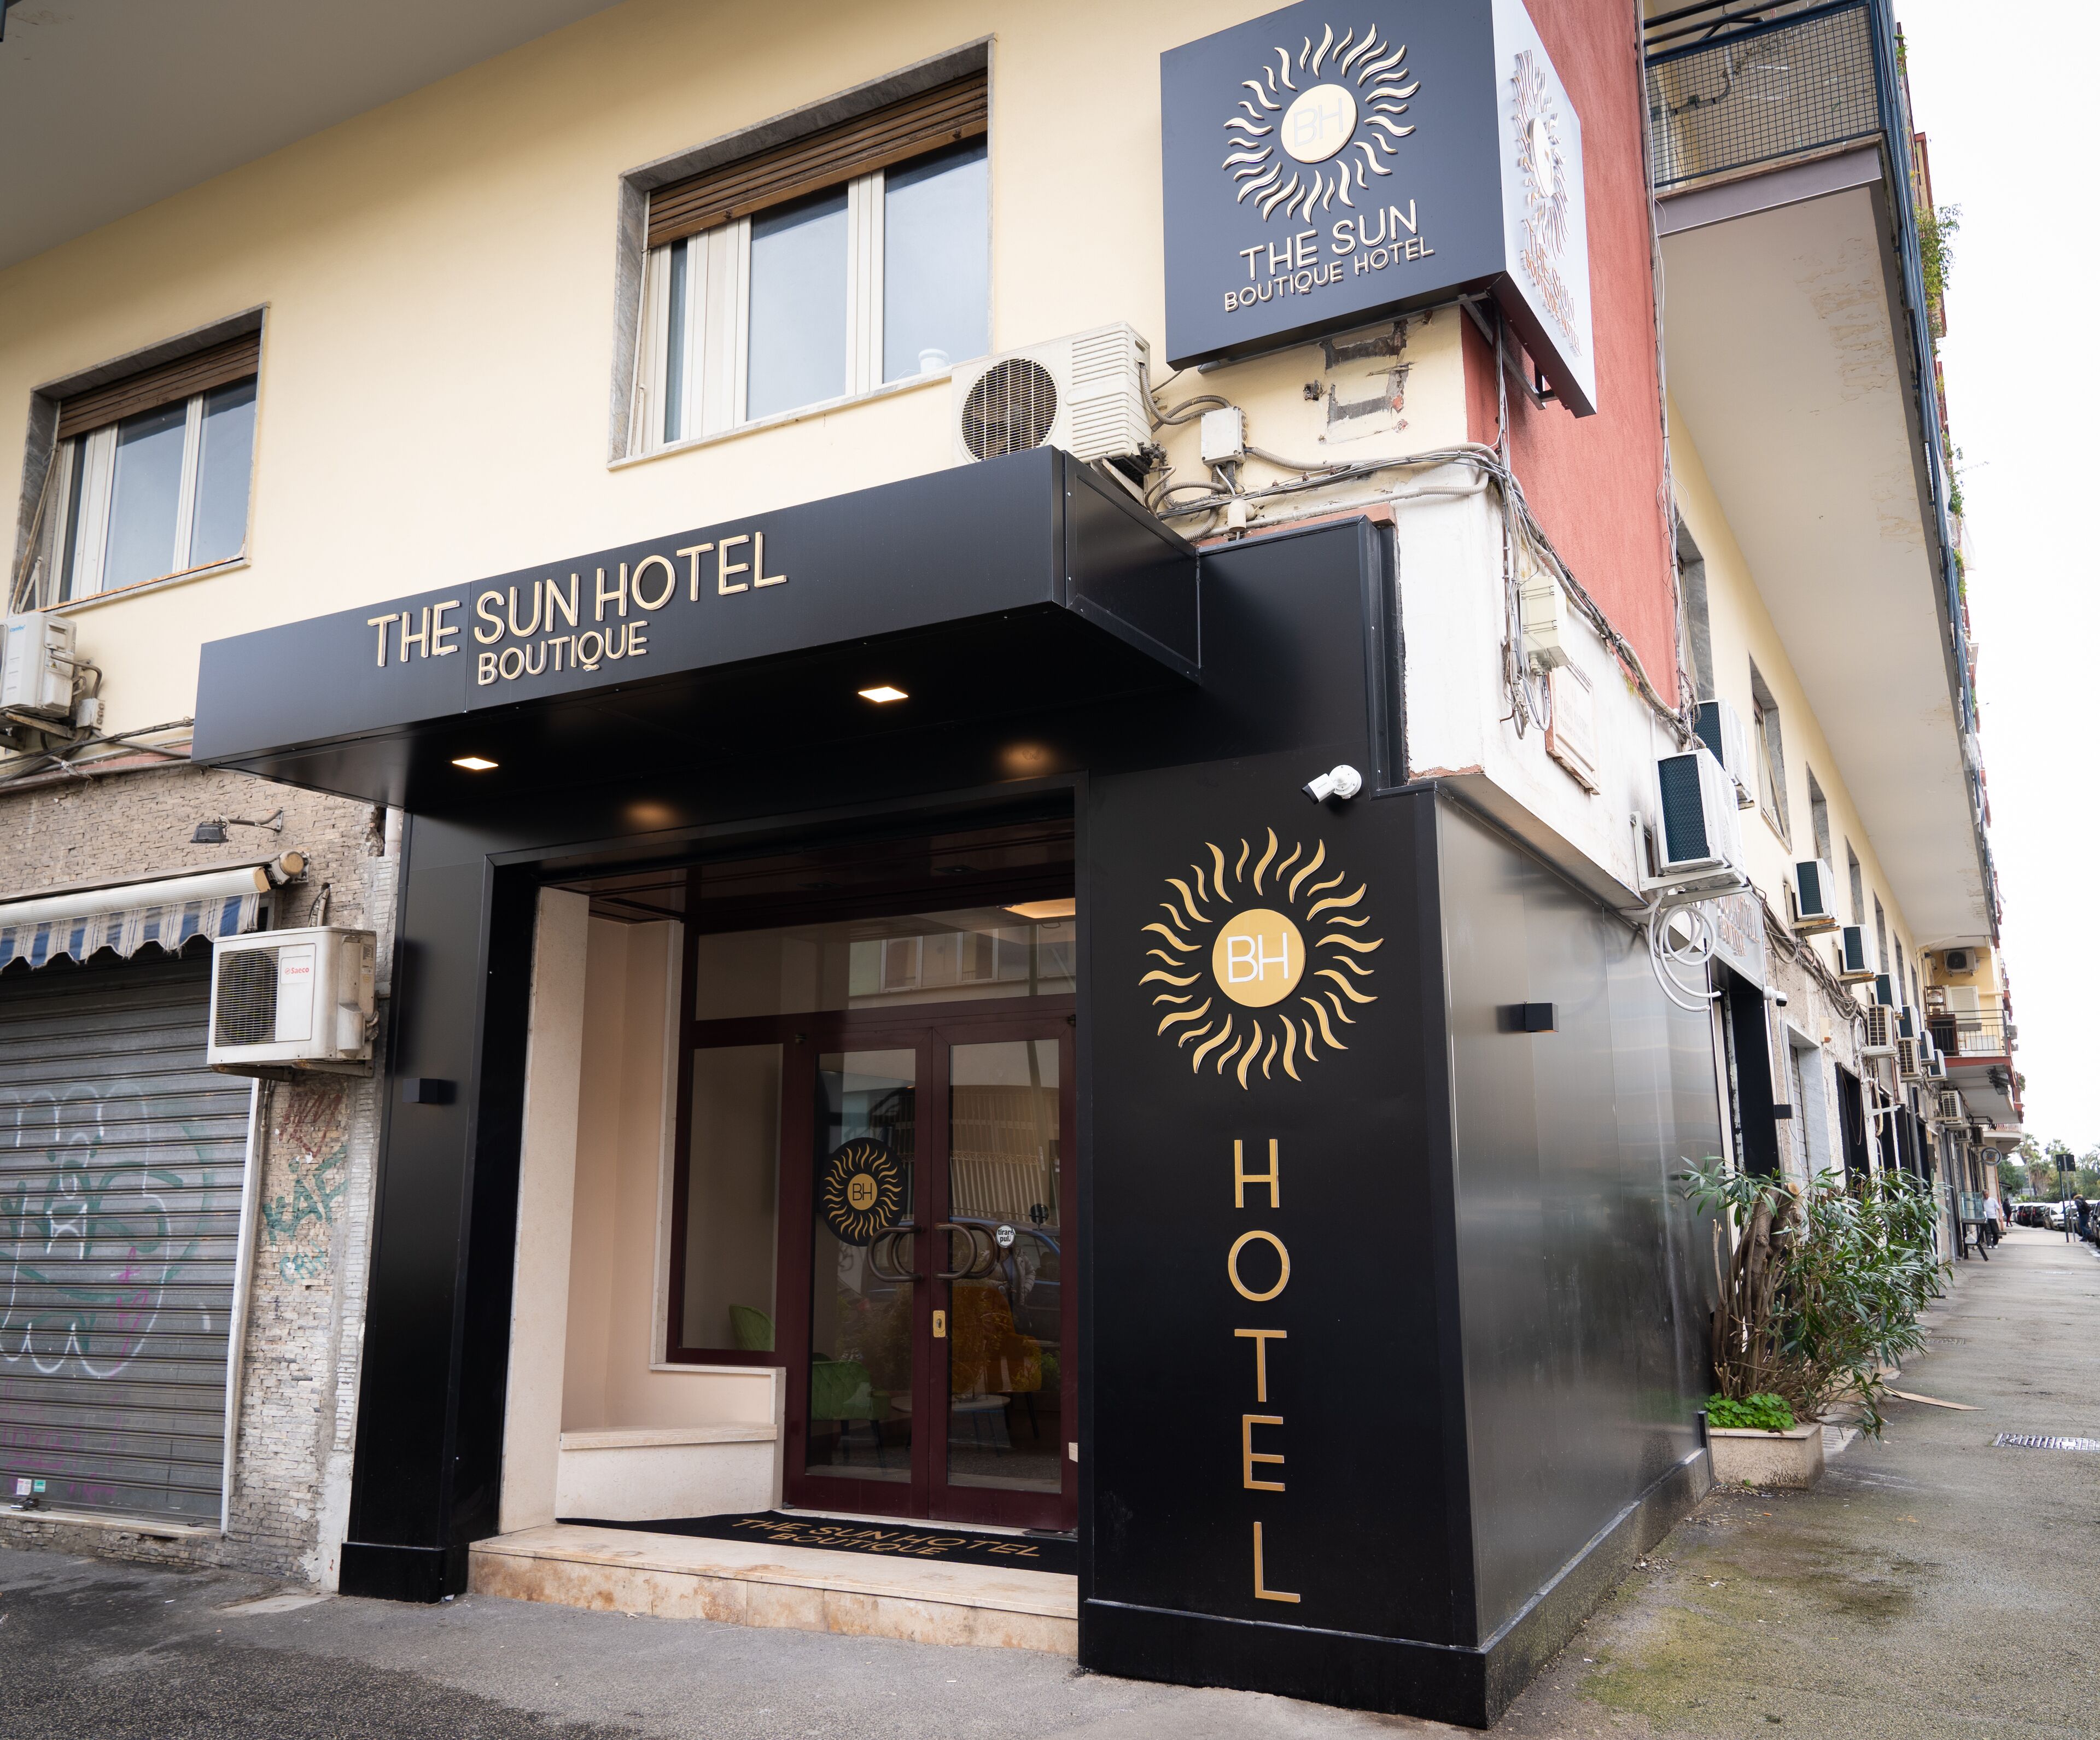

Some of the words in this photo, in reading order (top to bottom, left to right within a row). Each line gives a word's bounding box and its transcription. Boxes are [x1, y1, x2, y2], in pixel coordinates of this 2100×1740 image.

[1293, 97, 1345, 148] BH
[1240, 229, 1318, 281] THE
[1332, 199, 1418, 256] SUN
[1224, 262, 1343, 313] BOUTIQUE
[1355, 237, 1435, 276] HOTEL
[368, 600, 460, 667] THE
[474, 572, 580, 645] SUN
[596, 532, 788, 622] HOTEL
[477, 620, 649, 685] BOUTIQUE
[1227, 932, 1290, 983] BH
[852, 1182, 872, 1201] BH
[1227, 1138, 1301, 1603] HOTEL
[732, 1519, 813, 1532] THE
[809, 1527, 900, 1540] SUN
[894, 1533, 1041, 1557] HOTEL
[767, 1533, 949, 1555] BOUTIQUE
